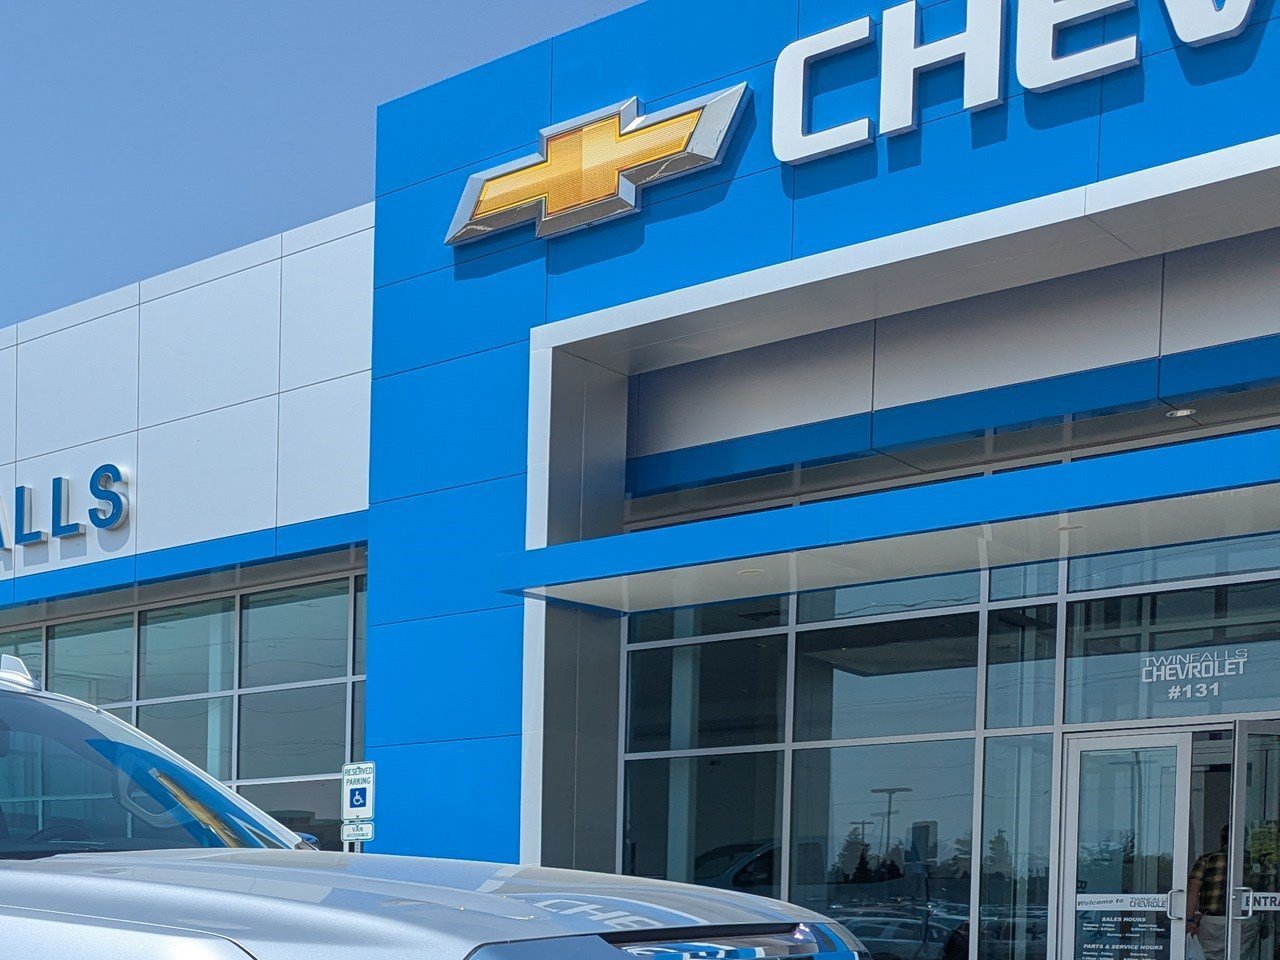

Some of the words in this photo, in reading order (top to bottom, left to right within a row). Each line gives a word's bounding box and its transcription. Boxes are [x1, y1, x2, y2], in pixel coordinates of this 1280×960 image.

[1142, 658, 1248, 683] CHEVROLET
[1168, 682, 1219, 700] #131
[345, 767, 373, 776] RESERVED
[346, 777, 371, 786] PARKING
